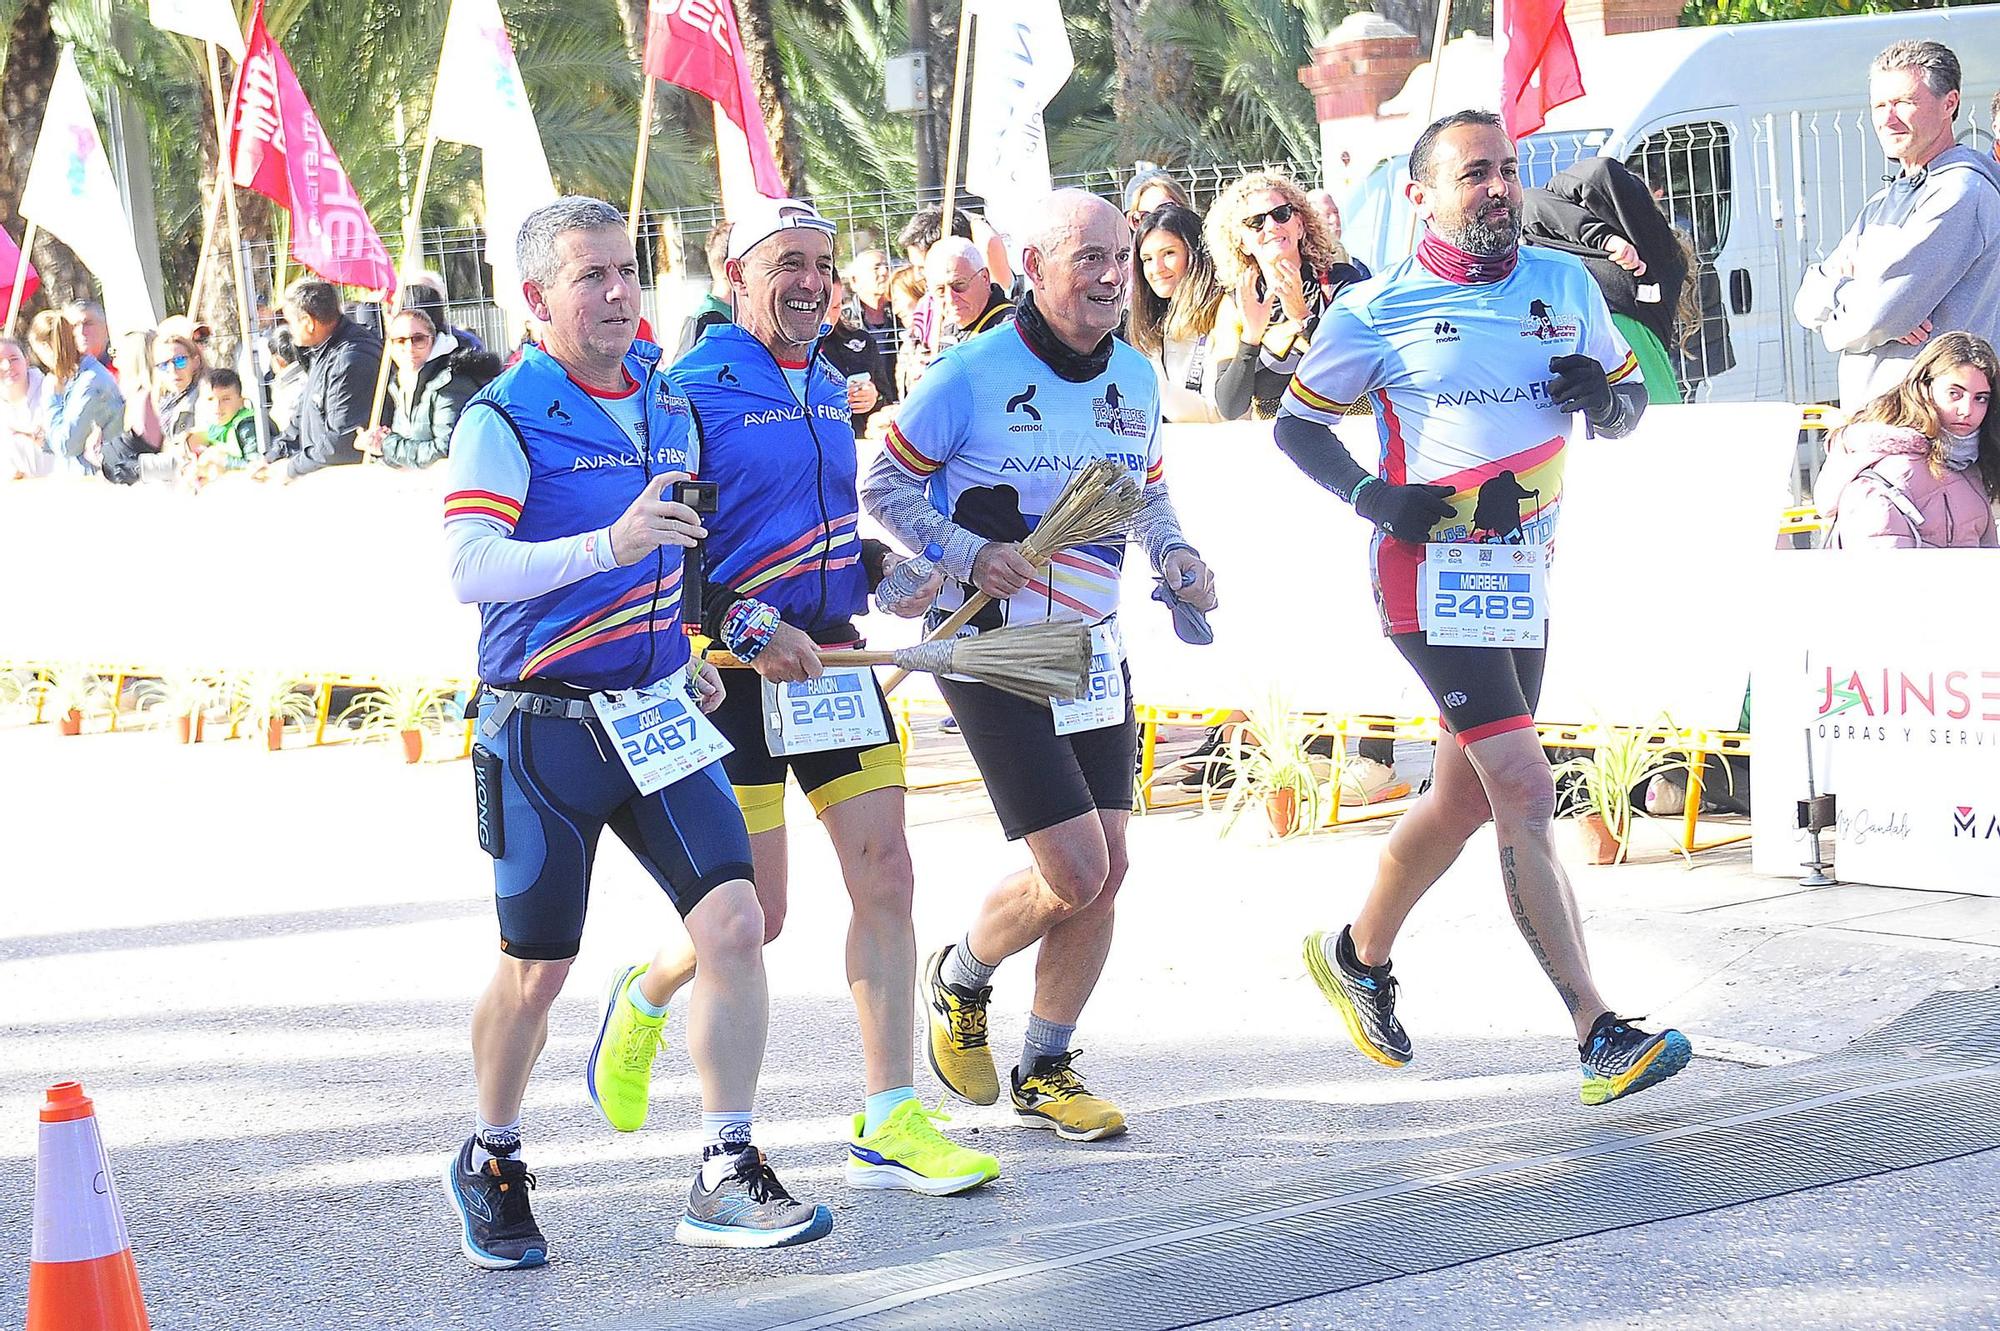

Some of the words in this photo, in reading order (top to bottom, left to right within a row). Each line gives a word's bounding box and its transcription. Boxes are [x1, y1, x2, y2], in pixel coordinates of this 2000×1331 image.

[1000, 454, 1101, 473] AVANZ
[1435, 594, 1534, 620] 2489
[808, 677, 840, 694] RAMON
[791, 695, 865, 725] 2491
[622, 716, 697, 766] 2487
[1818, 724, 1886, 741] OBRAS
[1903, 728, 1911, 742] Y
[475, 765, 490, 846] WONG
